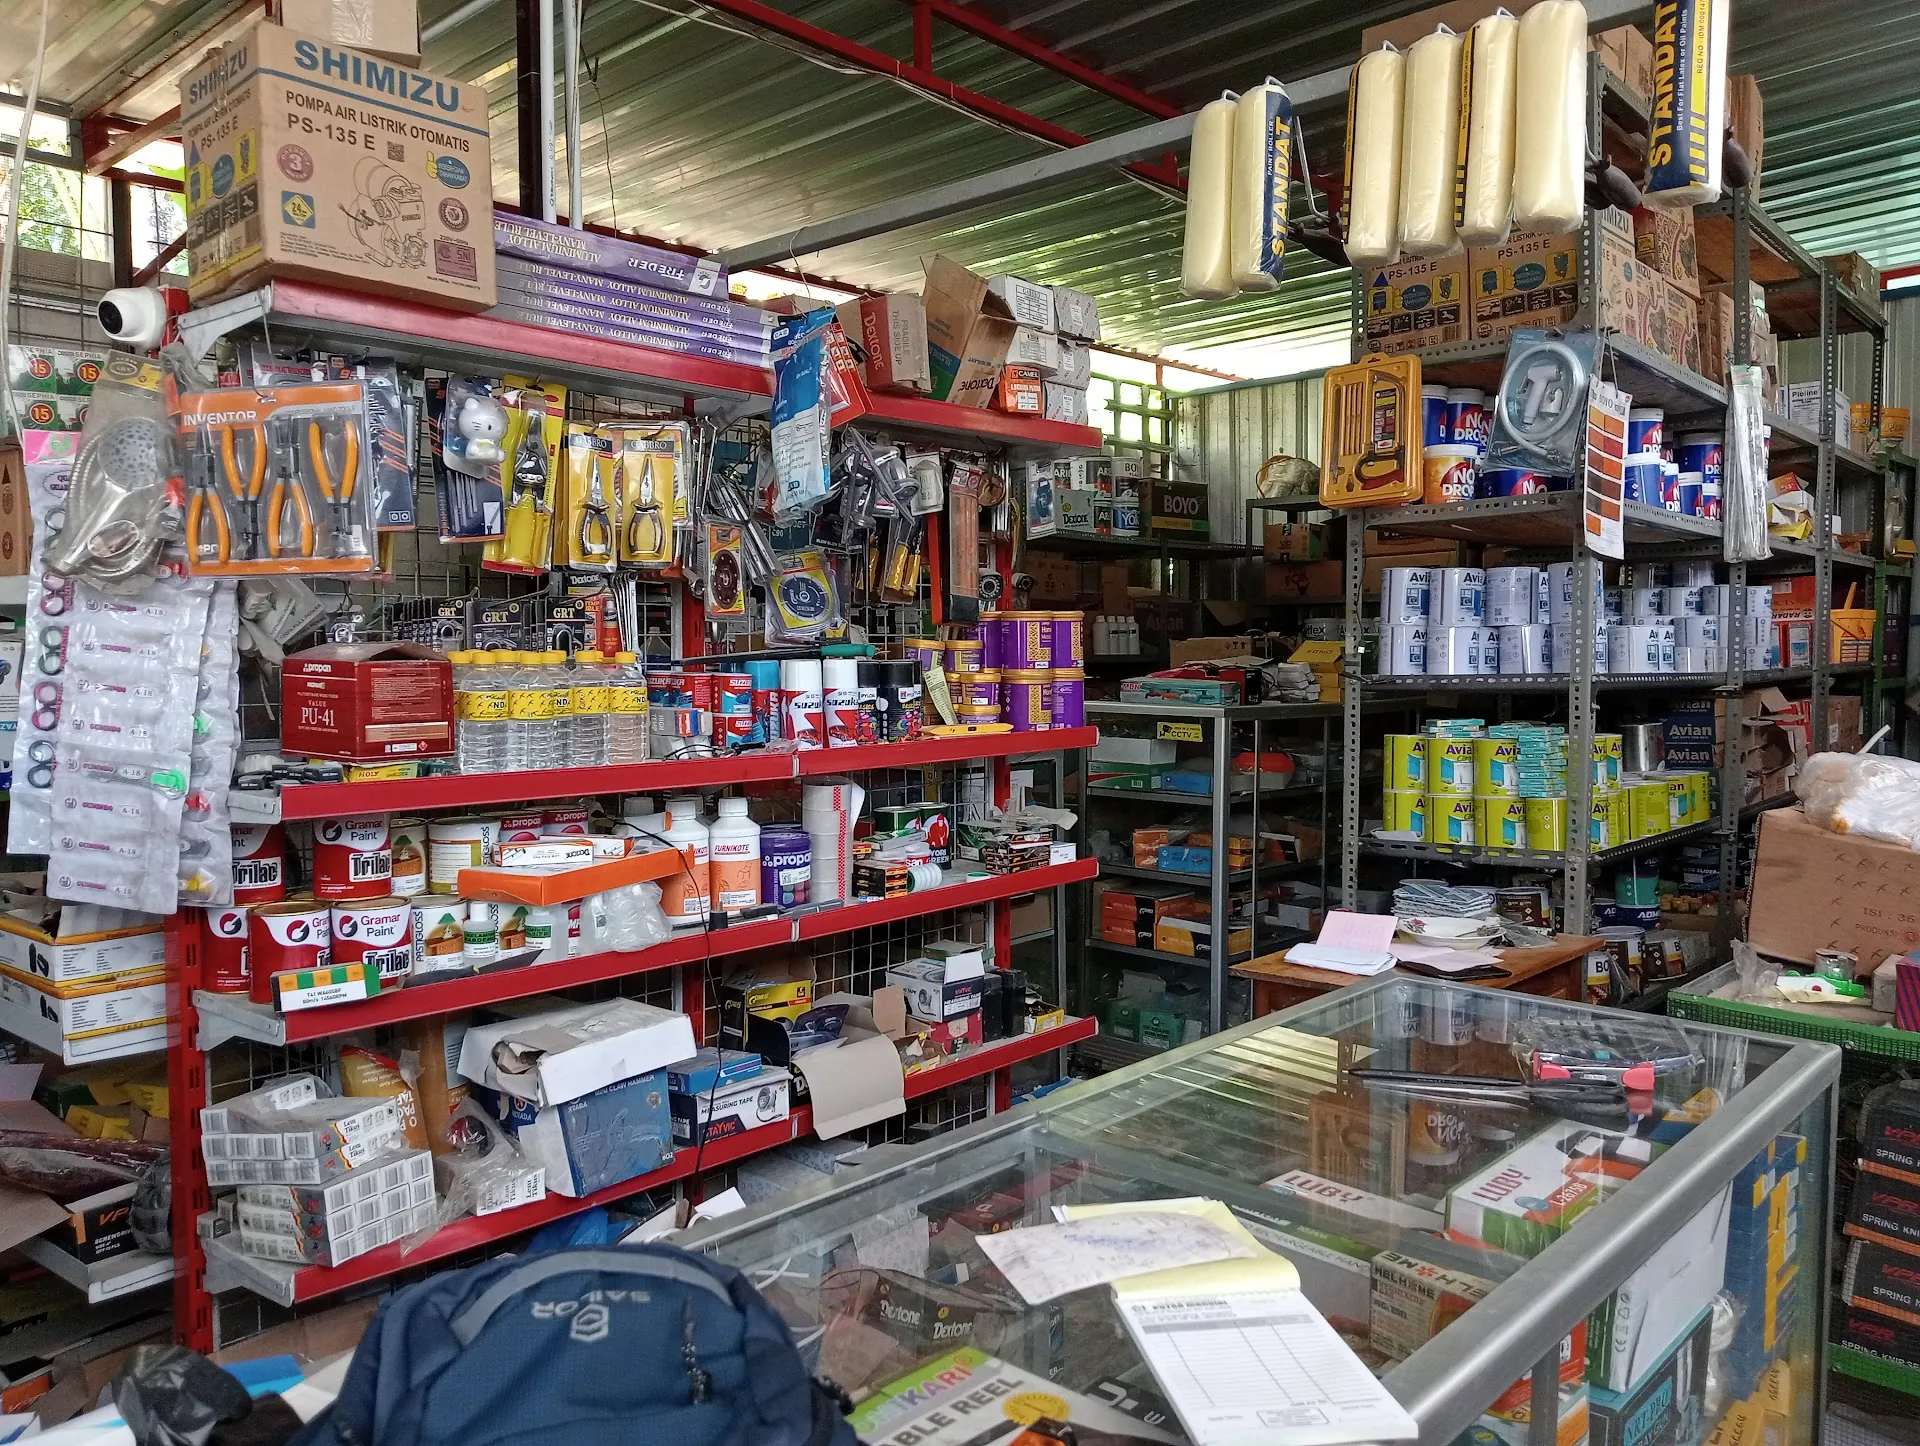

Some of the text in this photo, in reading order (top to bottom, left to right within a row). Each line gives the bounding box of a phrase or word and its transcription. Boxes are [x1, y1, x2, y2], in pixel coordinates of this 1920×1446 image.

[1680, 9, 1688, 34] Paints
[1680, 49, 1686, 57] or
[294, 39, 460, 113] SHIMIZU
[1651, 2, 1677, 168] STANDAT
[286, 91, 470, 153] POMPA AIR LISTRIK OTOMATIS
[287, 112, 376, 151] PS-135 E
[1267, 120, 1275, 151] ROLLER
[1271, 116, 1293, 257] STANDAT
[523, 224, 586, 250] MANY-LEVEL
[507, 233, 601, 263] ALUMINIUM ALLOY
[1497, 238, 1550, 260] PS-135 E
[628, 257, 685, 280] FREDER
[1387, 261, 1438, 281] PS-135 E
[543, 267, 604, 288] MANY-LEVEL
[546, 284, 606, 303] MANY-LEVEL
[606, 281, 638, 296] ALLOY
[638, 287, 688, 304] ALUMINIUM
[544, 299, 605, 319] MANY-LEVEL
[608, 296, 639, 311] ALLOY
[639, 303, 691, 320] ALUMINIUM
[544, 315, 604, 335] MANY-LEVEL
[607, 312, 638, 326] ALLOY
[891, 310, 899, 325] THIS
[607, 327, 638, 342] ALLOY
[638, 318, 691, 335] ALUMINIUM
[637, 333, 690, 350] ALUMINIUM
[863, 311, 884, 371] Dextone
[901, 318, 910, 357] FRAGILE
[33, 363, 47, 375] 15
[84, 368, 97, 379] 15
[1018, 369, 1039, 379] CAMEL
[26, 392, 55, 401] SEPHIA
[33, 409, 49, 421] 15
[183, 410, 258, 427] INVENTOR
[630, 439, 667, 450] GABBRO
[1453, 469, 1475, 484] NO
[1163, 494, 1200, 515] BOYO
[569, 573, 601, 586] Dextone
[438, 606, 457, 618] GRT
[481, 611, 510, 624] GRT
[552, 607, 576, 619] GRT
[301, 707, 335, 727] PU-41
[1171, 731, 1193, 740] CCTV
[1669, 723, 1712, 736] Avian
[1446, 744, 1473, 755] Avia
[1494, 745, 1520, 757] Avia
[1667, 749, 1710, 762] Avian
[1453, 803, 1474, 813] Avi
[1507, 804, 1526, 815] Avi
[231, 826, 255, 836] mar
[344, 820, 383, 831] Gramar
[232, 837, 246, 848] int
[351, 831, 379, 842] Paint
[714, 843, 751, 853] FURNIKOTE
[351, 853, 391, 877] Trilac
[312, 917, 330, 928] Gra
[361, 912, 401, 926] Gramar
[366, 925, 395, 938] Paint
[415, 911, 424, 963] PASTIGLOSS
[609, 1073, 656, 1093] CLAW HAMMER
[701, 1095, 754, 1116] MEASURING TAPE
[704, 1119, 737, 1139] TAYVIC
[1875, 1147, 1911, 1166] SPRING
[1283, 1173, 1364, 1203] LUBY
[1471, 1166, 1532, 1203] LUBY
[1861, 1212, 1920, 1238] SPRING KNI
[1872, 1285, 1910, 1305] SPRING
[932, 1320, 973, 1341] Dextone
[950, 1377, 1025, 1415] REEL
